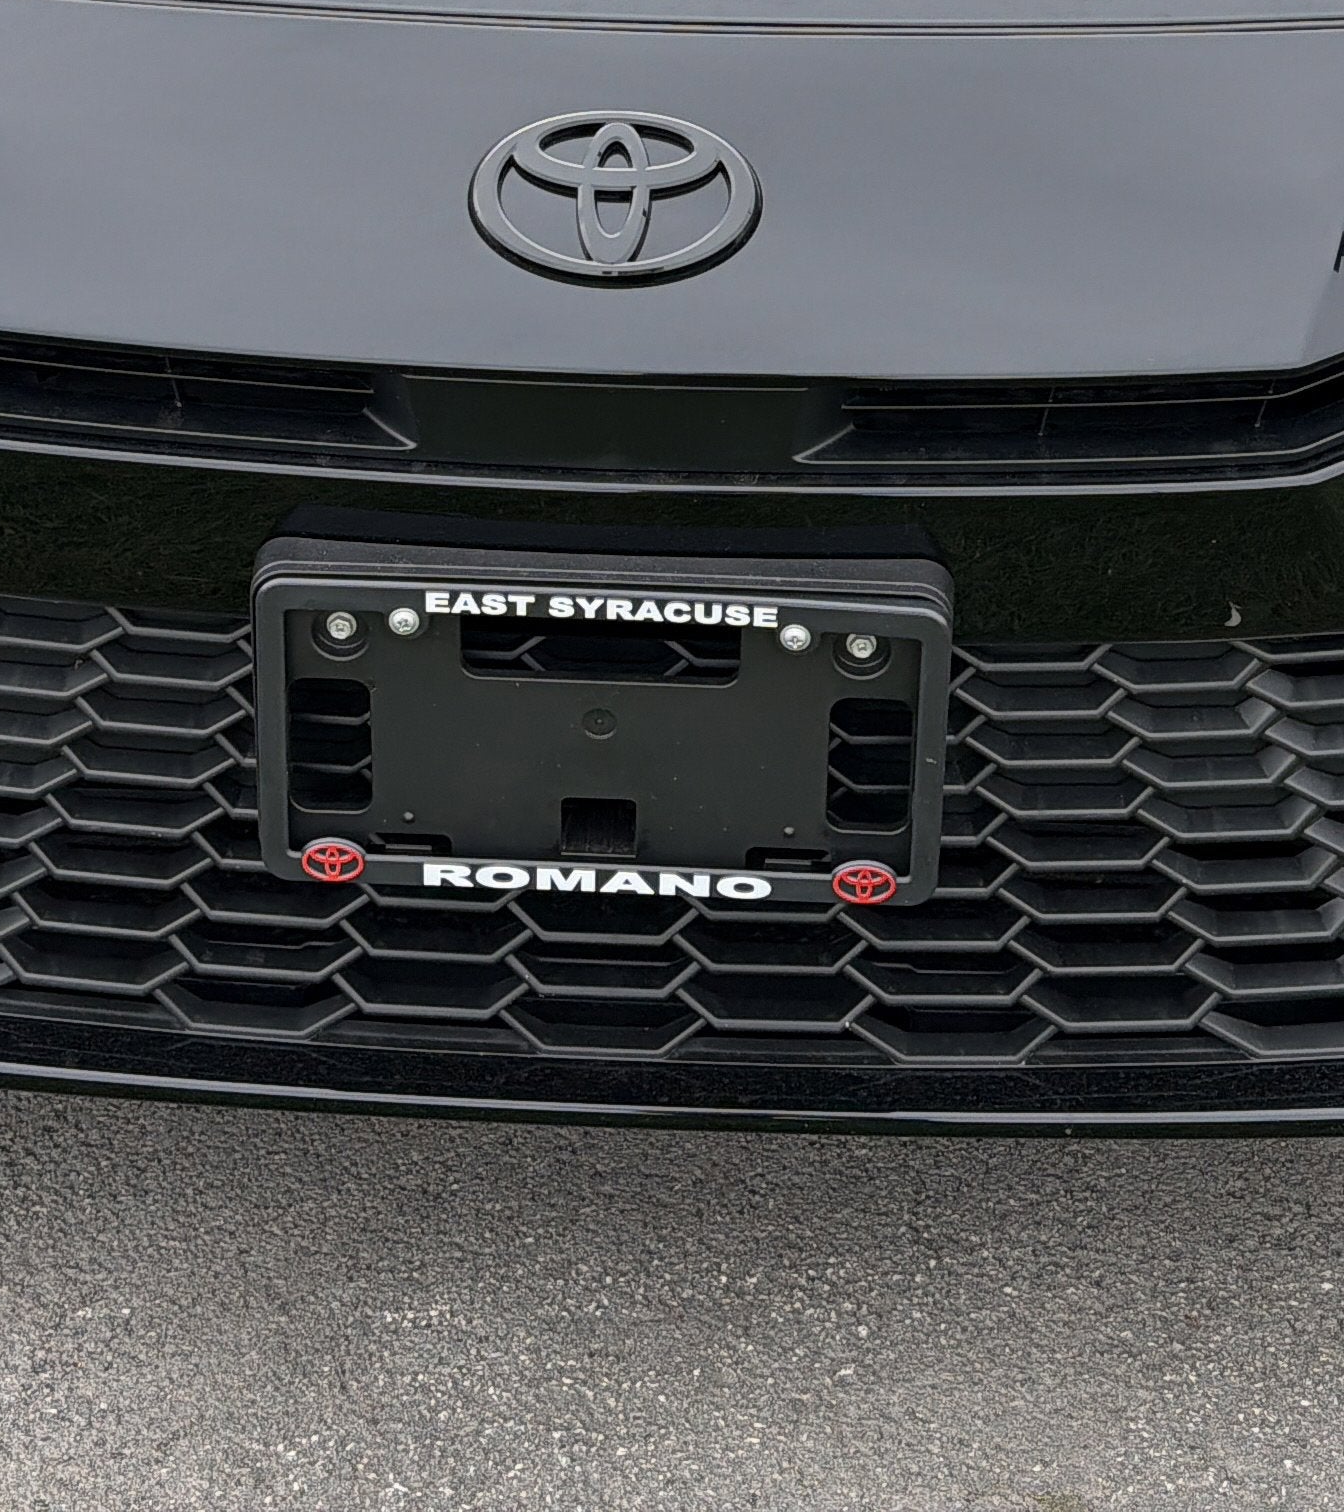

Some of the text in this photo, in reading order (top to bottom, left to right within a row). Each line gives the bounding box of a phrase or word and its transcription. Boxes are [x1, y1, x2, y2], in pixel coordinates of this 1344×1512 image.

[424, 591, 779, 628] EAST SYRACUSE
[423, 863, 772, 900] ROMANO
